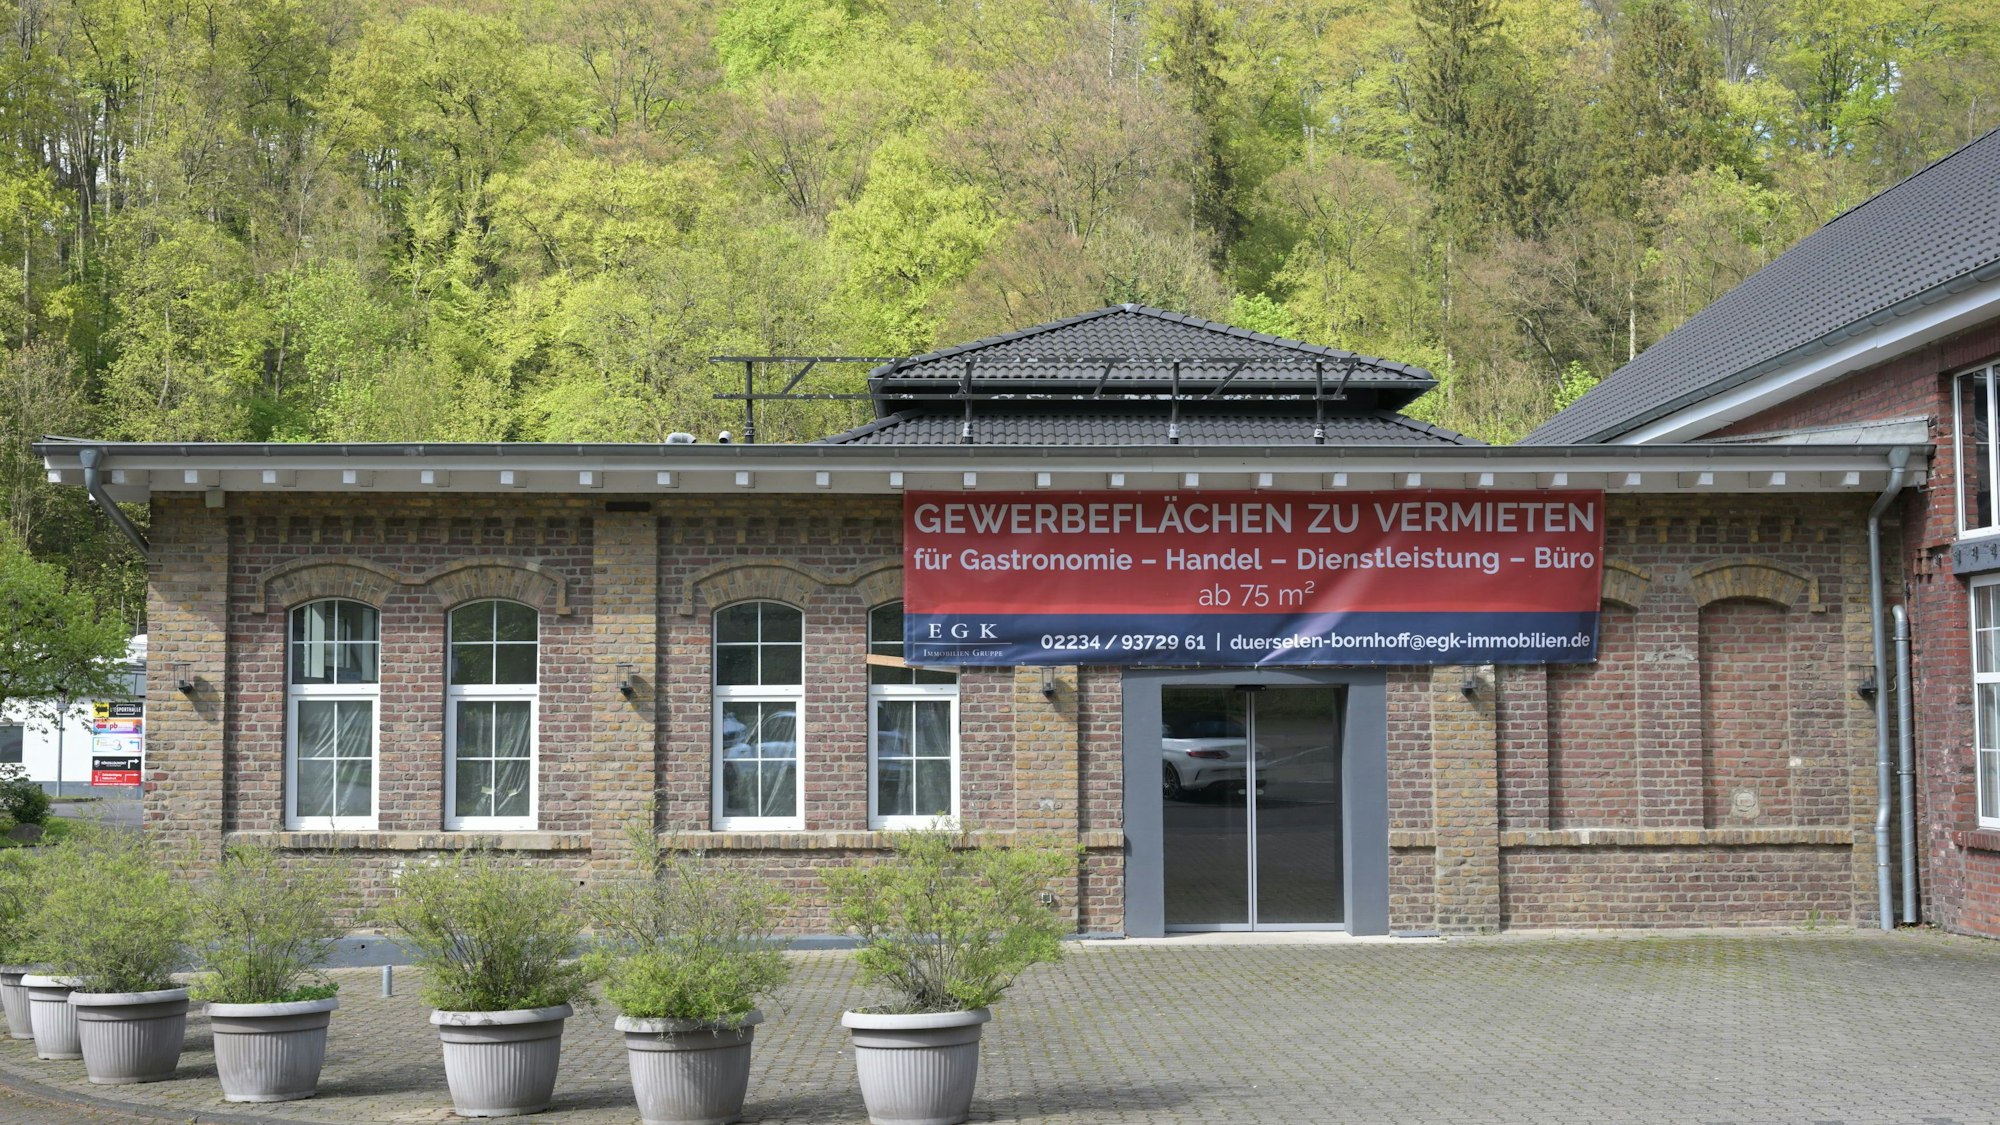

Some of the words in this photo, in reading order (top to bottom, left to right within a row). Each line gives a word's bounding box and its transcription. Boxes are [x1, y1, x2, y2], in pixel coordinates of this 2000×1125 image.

[914, 496, 1292, 534] GEWERBEFLÄCHEN
[1307, 503, 1359, 533] ZU
[1374, 502, 1594, 533] VERMIETEN
[914, 548, 952, 570] für
[960, 548, 1133, 571] Gastronomie
[1166, 548, 1263, 570] Handel
[1298, 546, 1500, 575] Dienstleistung
[1535, 547, 1595, 569] Büro
[1199, 583, 1231, 607] ab
[1240, 584, 1269, 607] 75
[1279, 580, 1315, 606] m²
[1041, 634, 1100, 650] 02234
[1122, 634, 1179, 650] 93729
[1185, 634, 1206, 650] 61
[1230, 632, 1591, 652] duerselen-bornhoff@egk-immobilien.de
